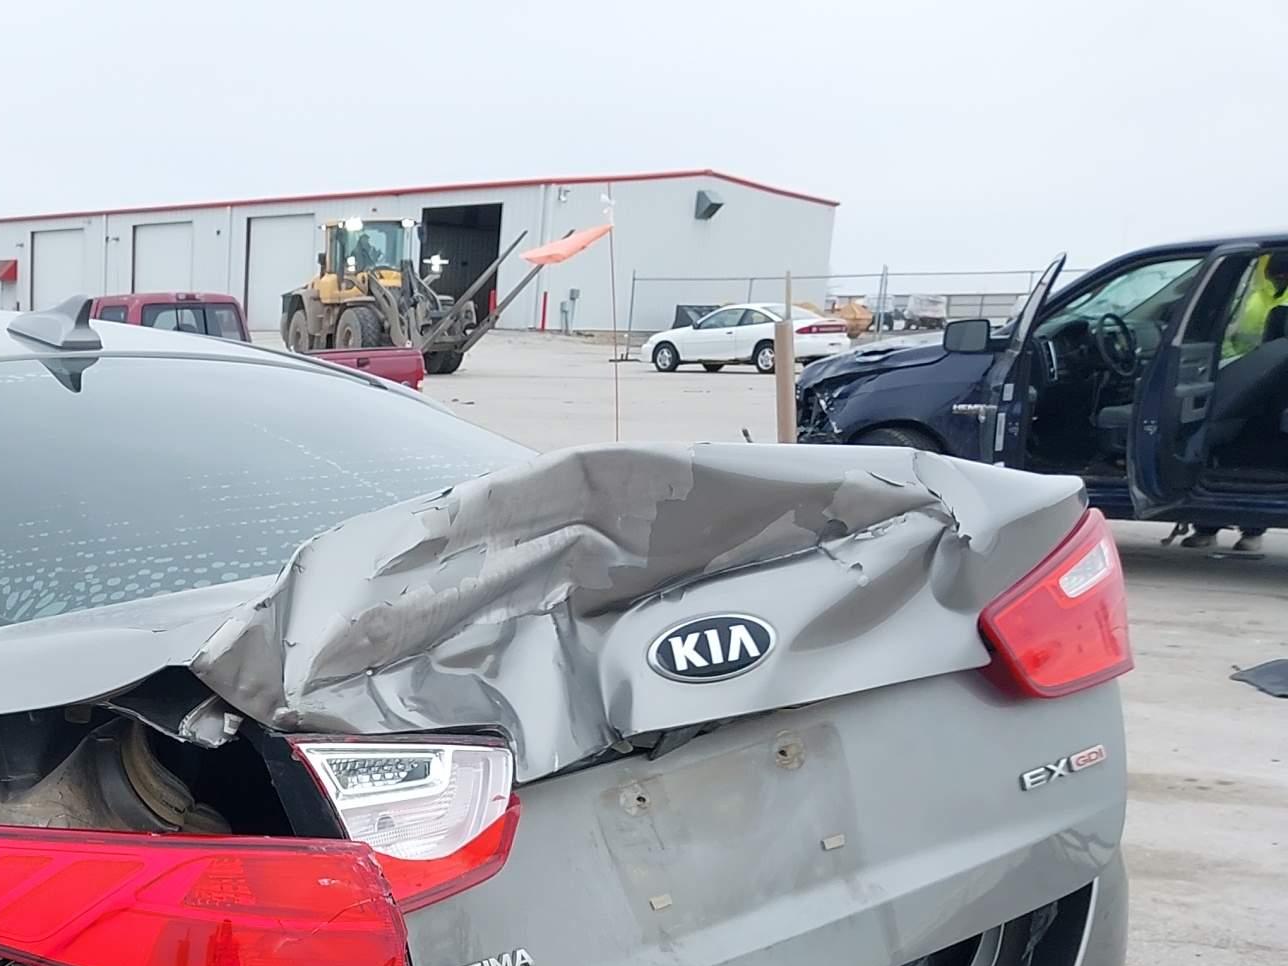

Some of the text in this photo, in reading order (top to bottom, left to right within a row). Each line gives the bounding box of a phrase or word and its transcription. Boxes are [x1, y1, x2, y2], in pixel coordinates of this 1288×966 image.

[668, 624, 761, 671] KIA
[1020, 747, 1104, 790] EX GDI
